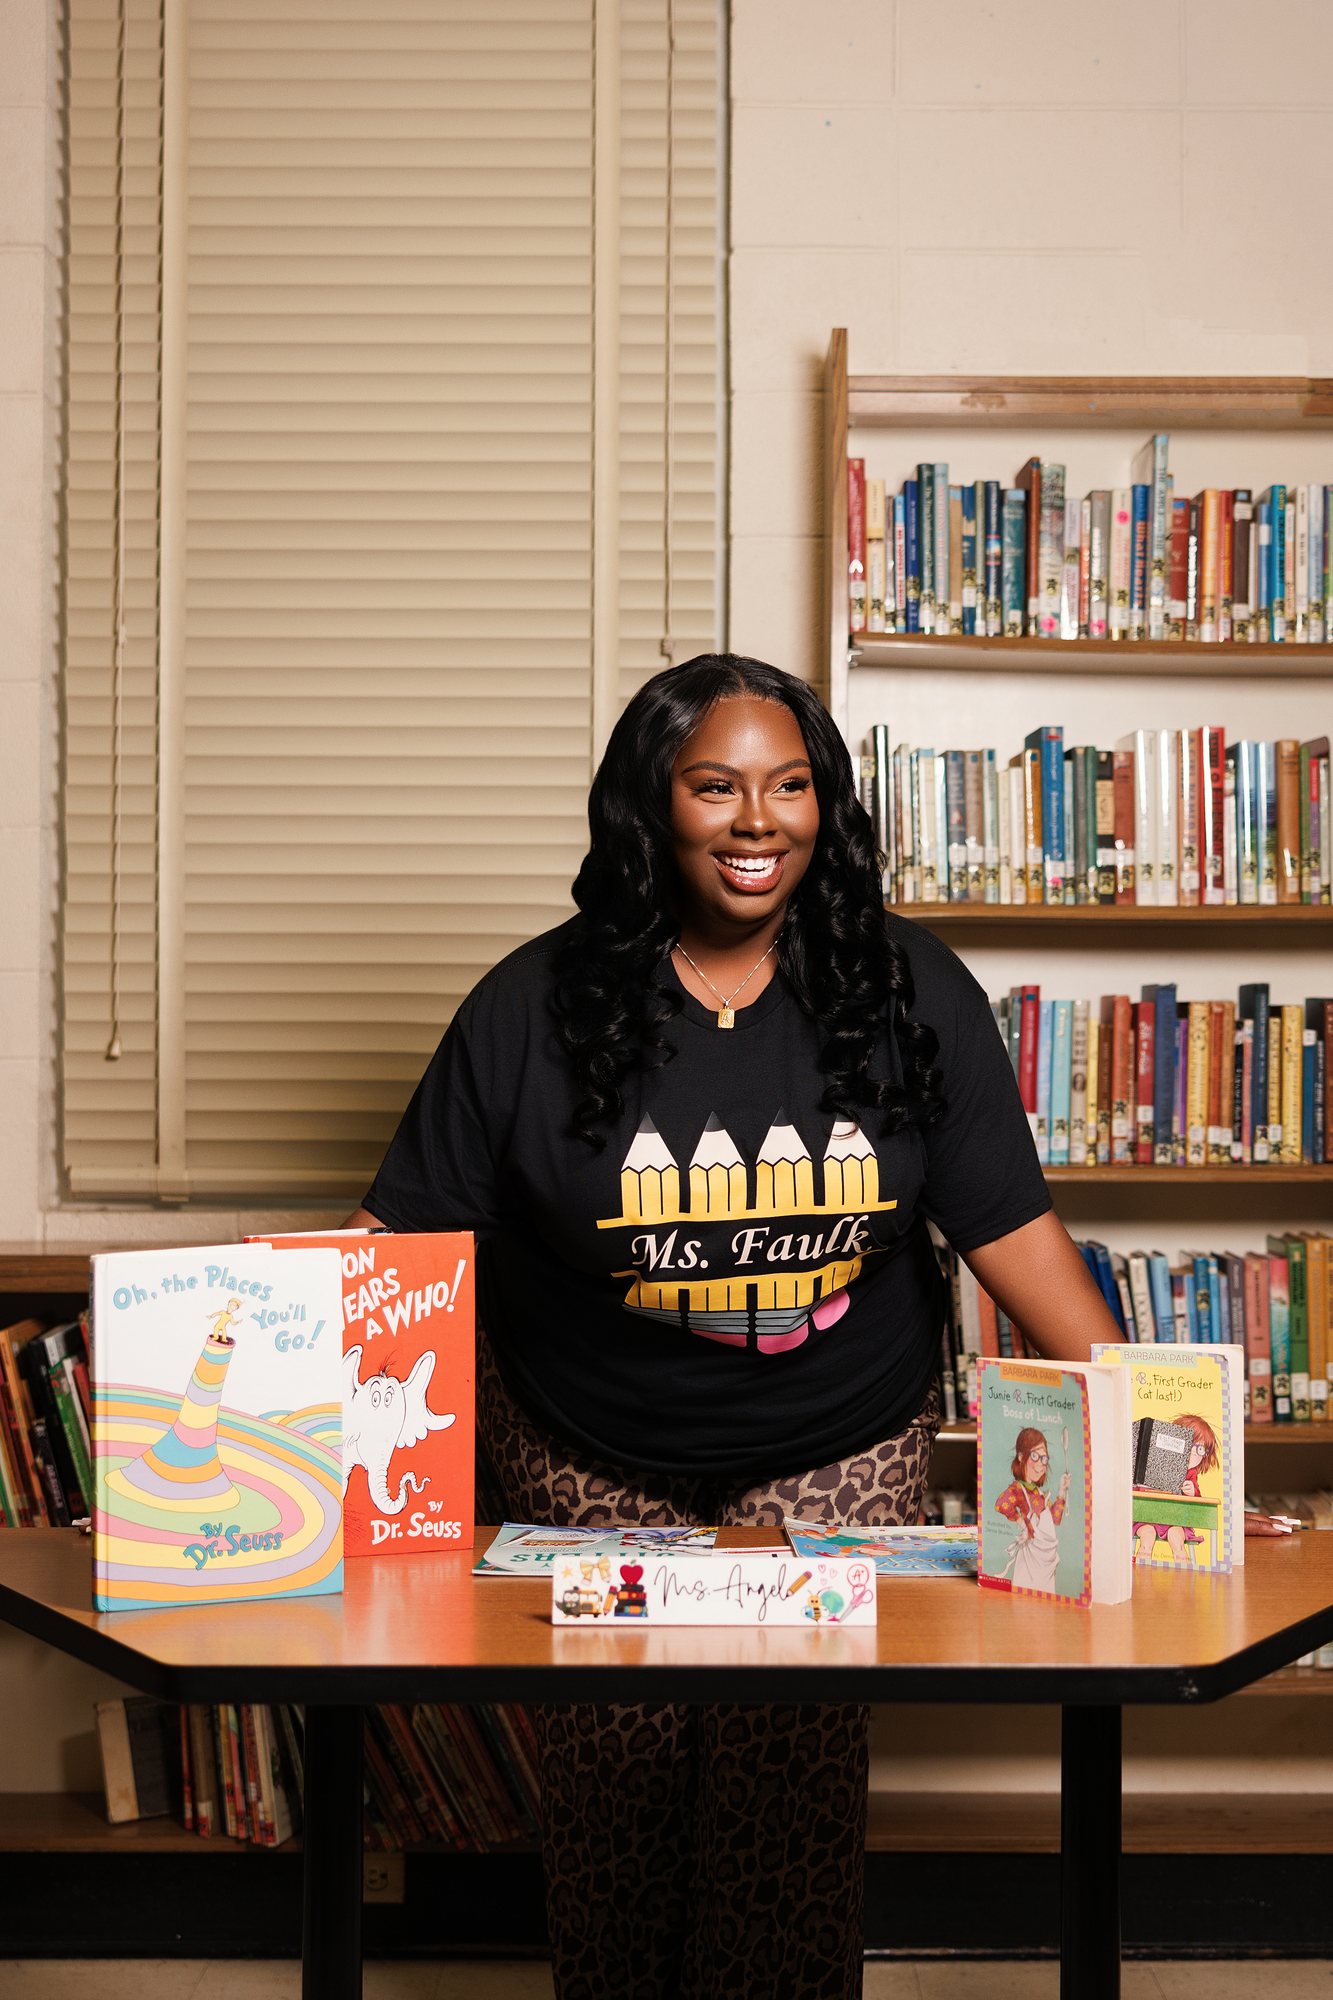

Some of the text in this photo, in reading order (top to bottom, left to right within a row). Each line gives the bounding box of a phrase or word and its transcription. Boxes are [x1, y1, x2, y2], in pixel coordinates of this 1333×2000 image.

[631, 1214, 873, 1272] Ms. Faulk
[113, 1265, 274, 1310] Oh, the Places
[342, 1267, 401, 1331] EARS
[365, 1259, 467, 1341] A WHO!
[250, 1303, 307, 1330] You'll
[274, 1320, 326, 1353] Go!
[1123, 1350, 1194, 1364] BARBARA PARK
[1002, 1366, 1060, 1383] BARBARA PARK
[1153, 1374, 1174, 1387] First
[1177, 1376, 1214, 1390] Grader
[988, 1386, 1011, 1401] Junie
[1026, 1392, 1045, 1406] First
[1047, 1395, 1076, 1410] Grader
[1137, 1387, 1183, 1402] (at last!)
[1002, 1405, 1063, 1425] Boss of Lunch
[427, 1500, 444, 1514] By
[199, 1521, 224, 1540] By
[370, 1512, 462, 1546] Dr. Seuss
[183, 1525, 285, 1571] Dr. Seuss
[653, 1563, 788, 1622] Ms. Angel
